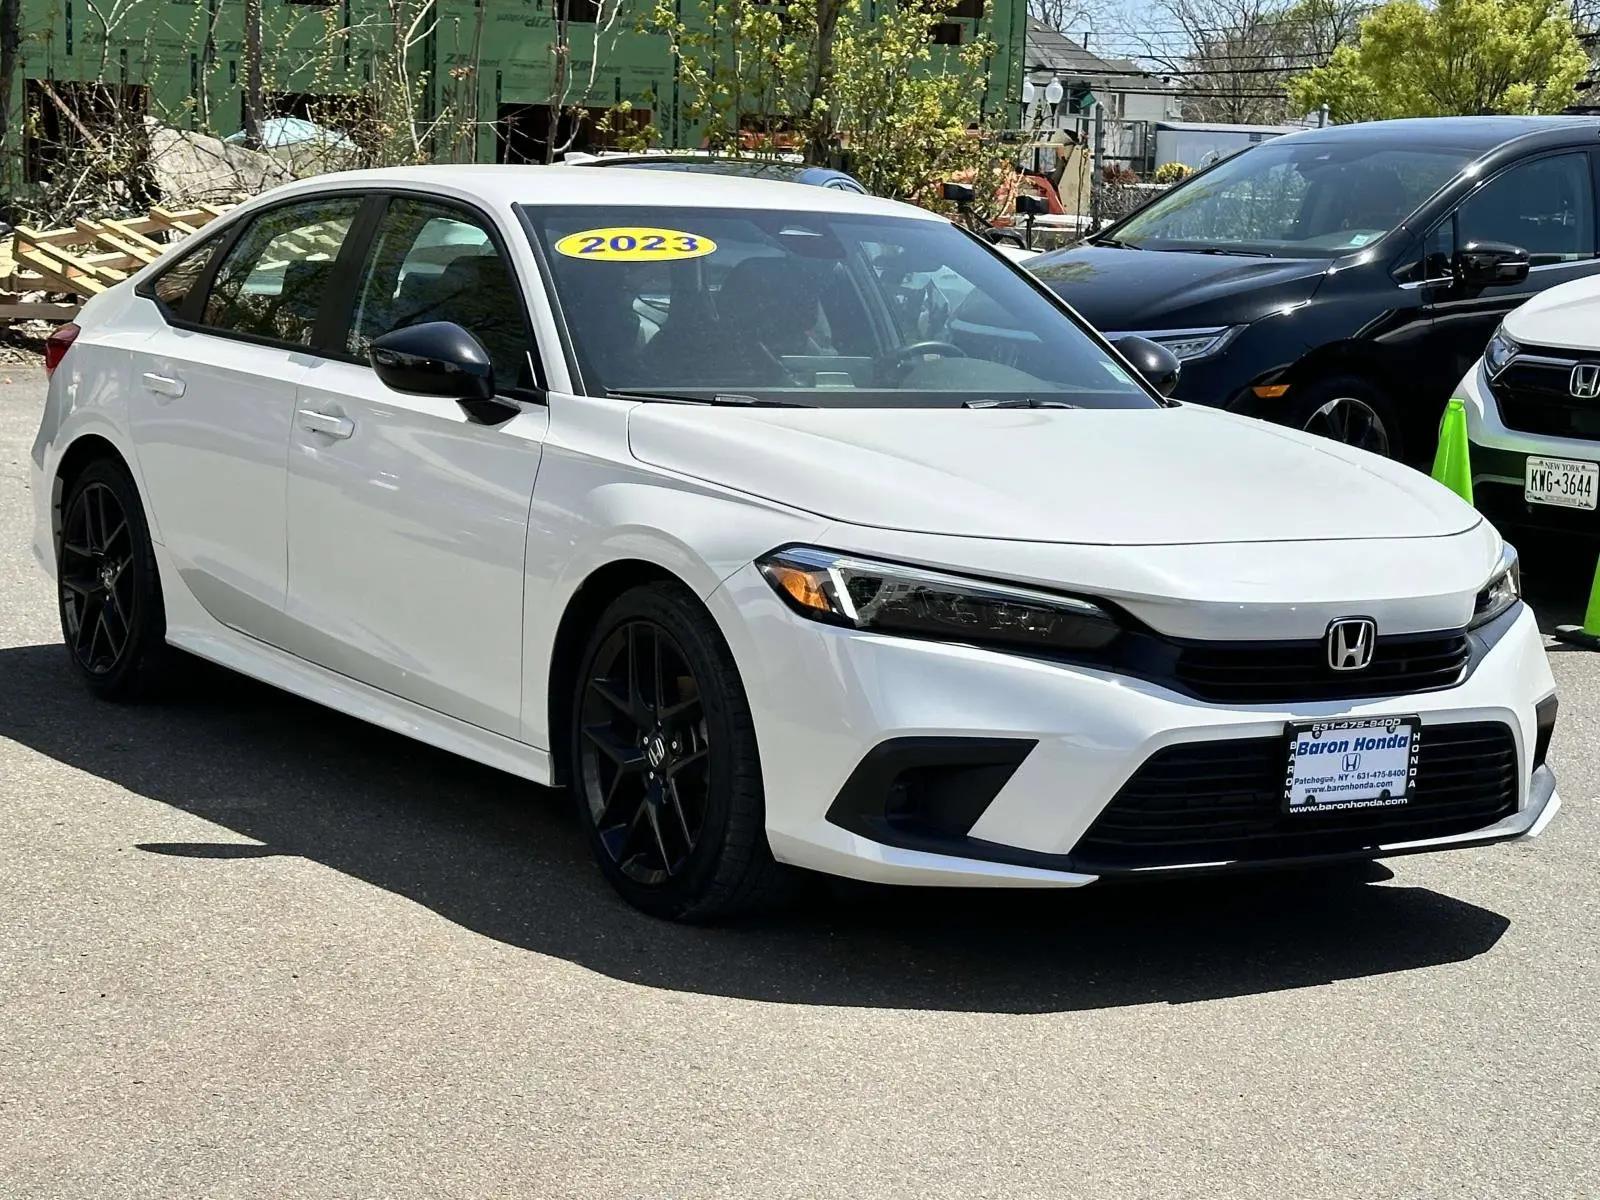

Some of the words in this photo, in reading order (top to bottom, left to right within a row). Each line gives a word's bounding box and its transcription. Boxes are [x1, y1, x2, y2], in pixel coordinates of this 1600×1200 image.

[578, 235, 699, 254] 2023
[1545, 461, 1560, 470] NEW
[1562, 464, 1580, 472] YORK
[1312, 718, 1401, 731] 631-475-8400
[1297, 740, 1349, 756] Baron
[1353, 734, 1409, 751] Honda
[1408, 732, 1421, 788] HONDA
[1284, 741, 1297, 799] BARON
[1294, 776, 1336, 786] Patchogue,
[1356, 769, 1406, 780] 631-475-8400
[1304, 780, 1393, 794] www.baronhonda.com
[1289, 798, 1408, 814] www.baronhonda.com
